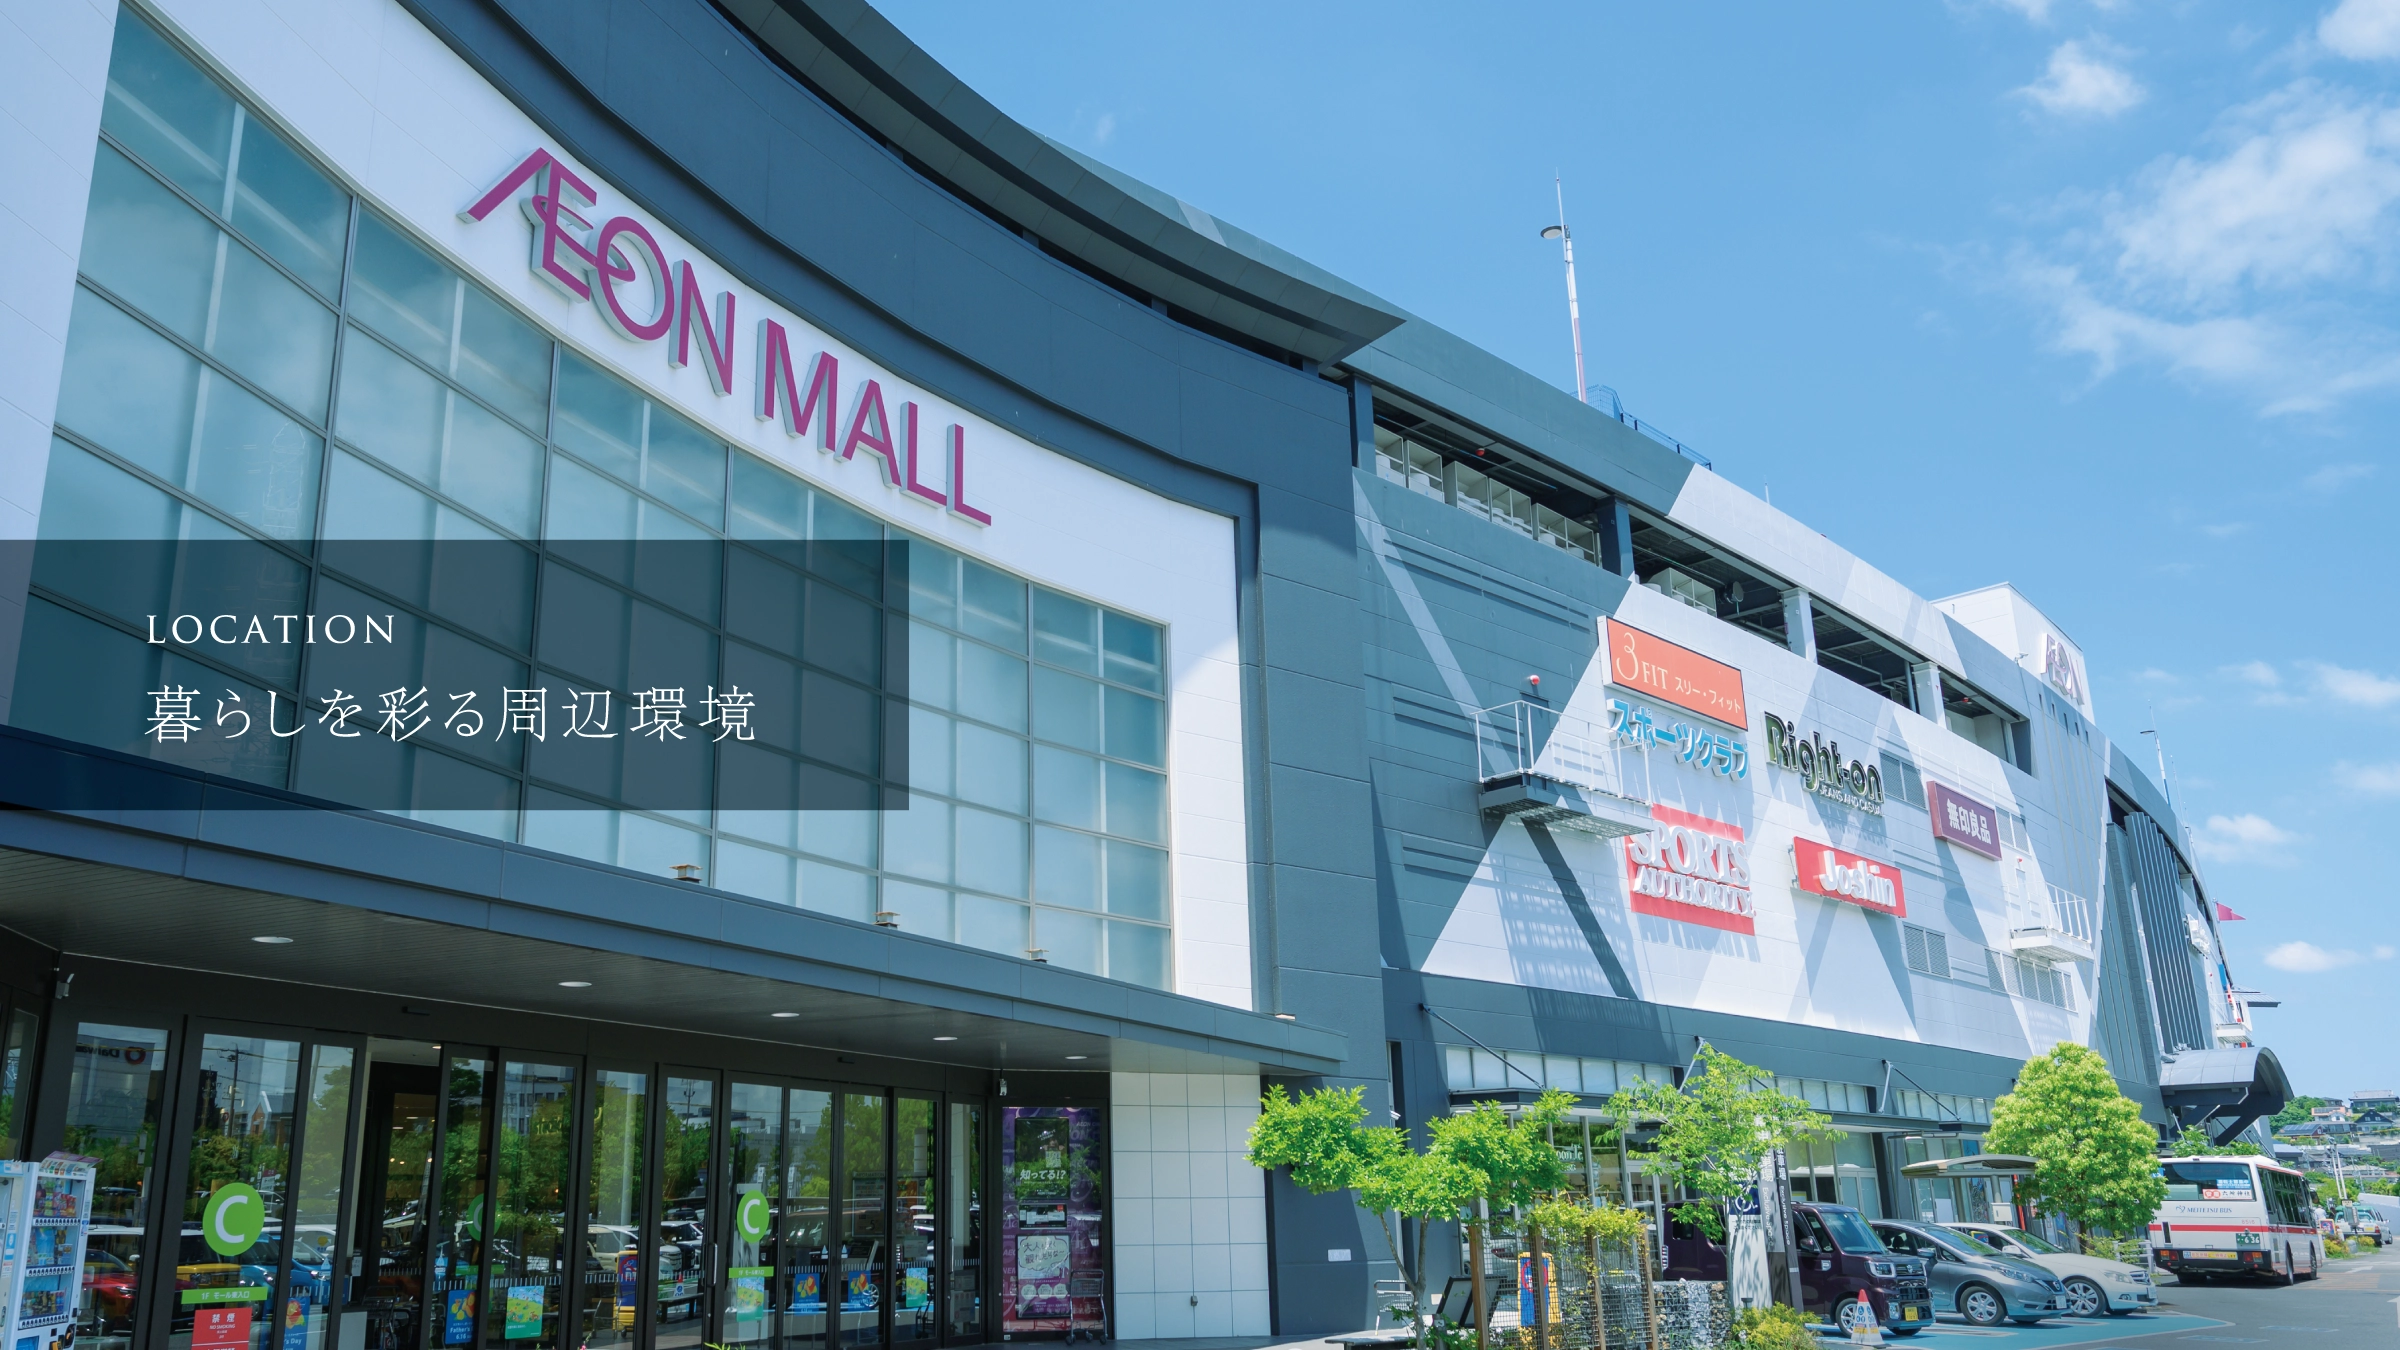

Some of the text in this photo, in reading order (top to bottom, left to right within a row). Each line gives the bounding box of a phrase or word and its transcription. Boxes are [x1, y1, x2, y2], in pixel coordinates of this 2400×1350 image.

[755, 318, 991, 529] MALL
[1609, 698, 1749, 779] スポーツクラブ
[1761, 711, 1884, 803] Right-on
[1946, 798, 1992, 845] 無印良品
[1629, 820, 1752, 887] SPORTS
[1819, 850, 1897, 907] Joshin
[215, 1195, 248, 1244] C
[743, 1199, 760, 1234] C
[1762, 1187, 1772, 1220] Exclusive
[1780, 1185, 1788, 1219] Exclusive
[201, 1290, 250, 1300] 1F モール東入口
[450, 1326, 471, 1334] Father's
